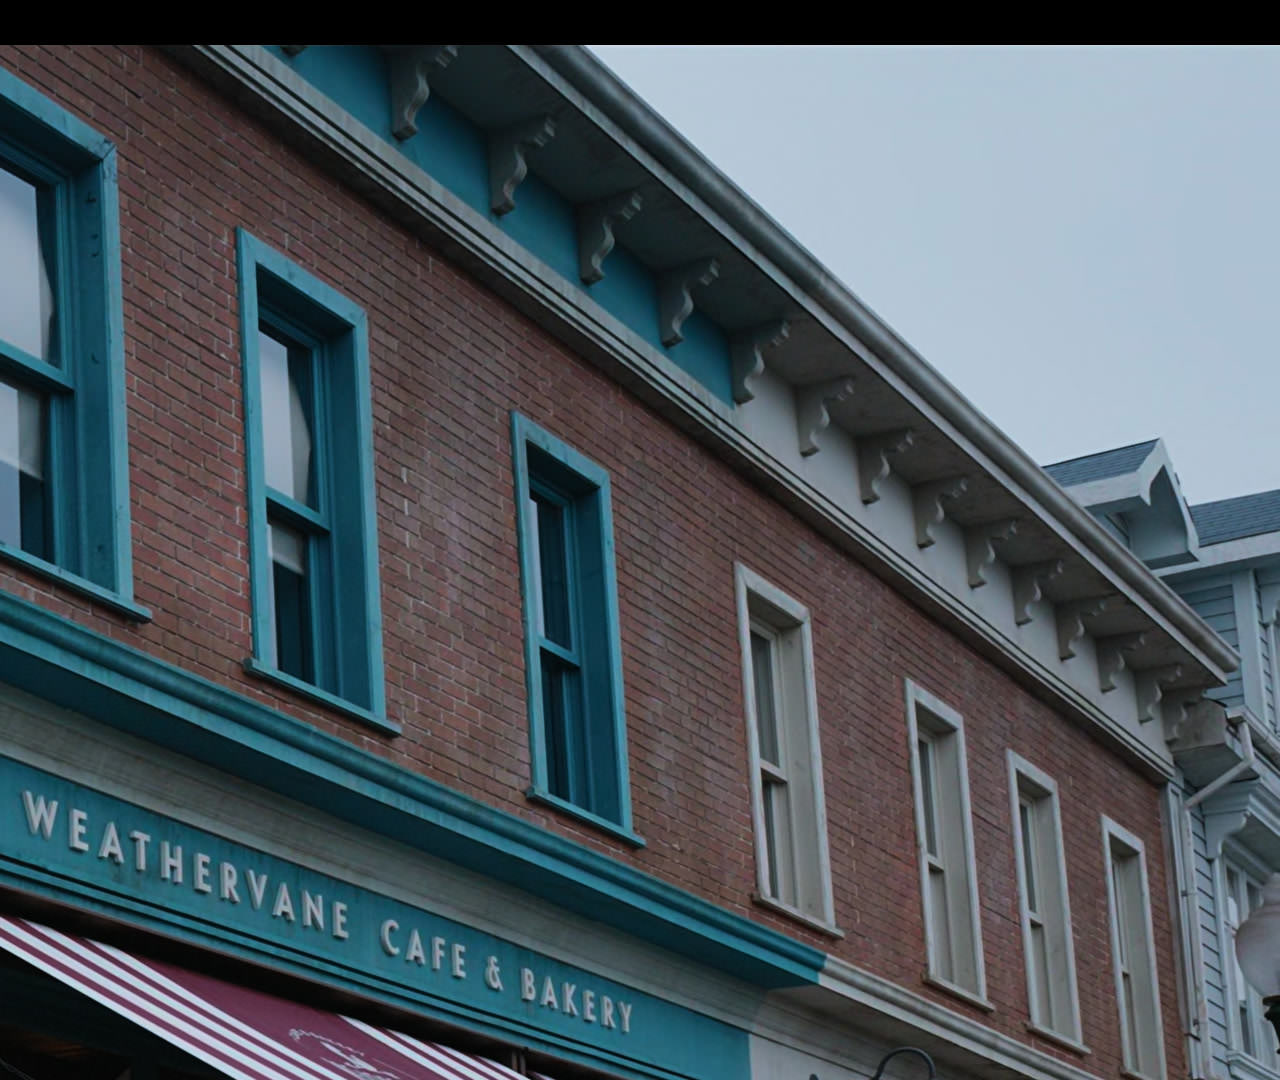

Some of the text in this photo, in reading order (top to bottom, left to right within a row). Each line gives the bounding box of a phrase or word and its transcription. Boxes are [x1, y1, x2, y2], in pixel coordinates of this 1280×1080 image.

[22, 790, 633, 1034] WEATHERVANE CAFE & BAKERY
